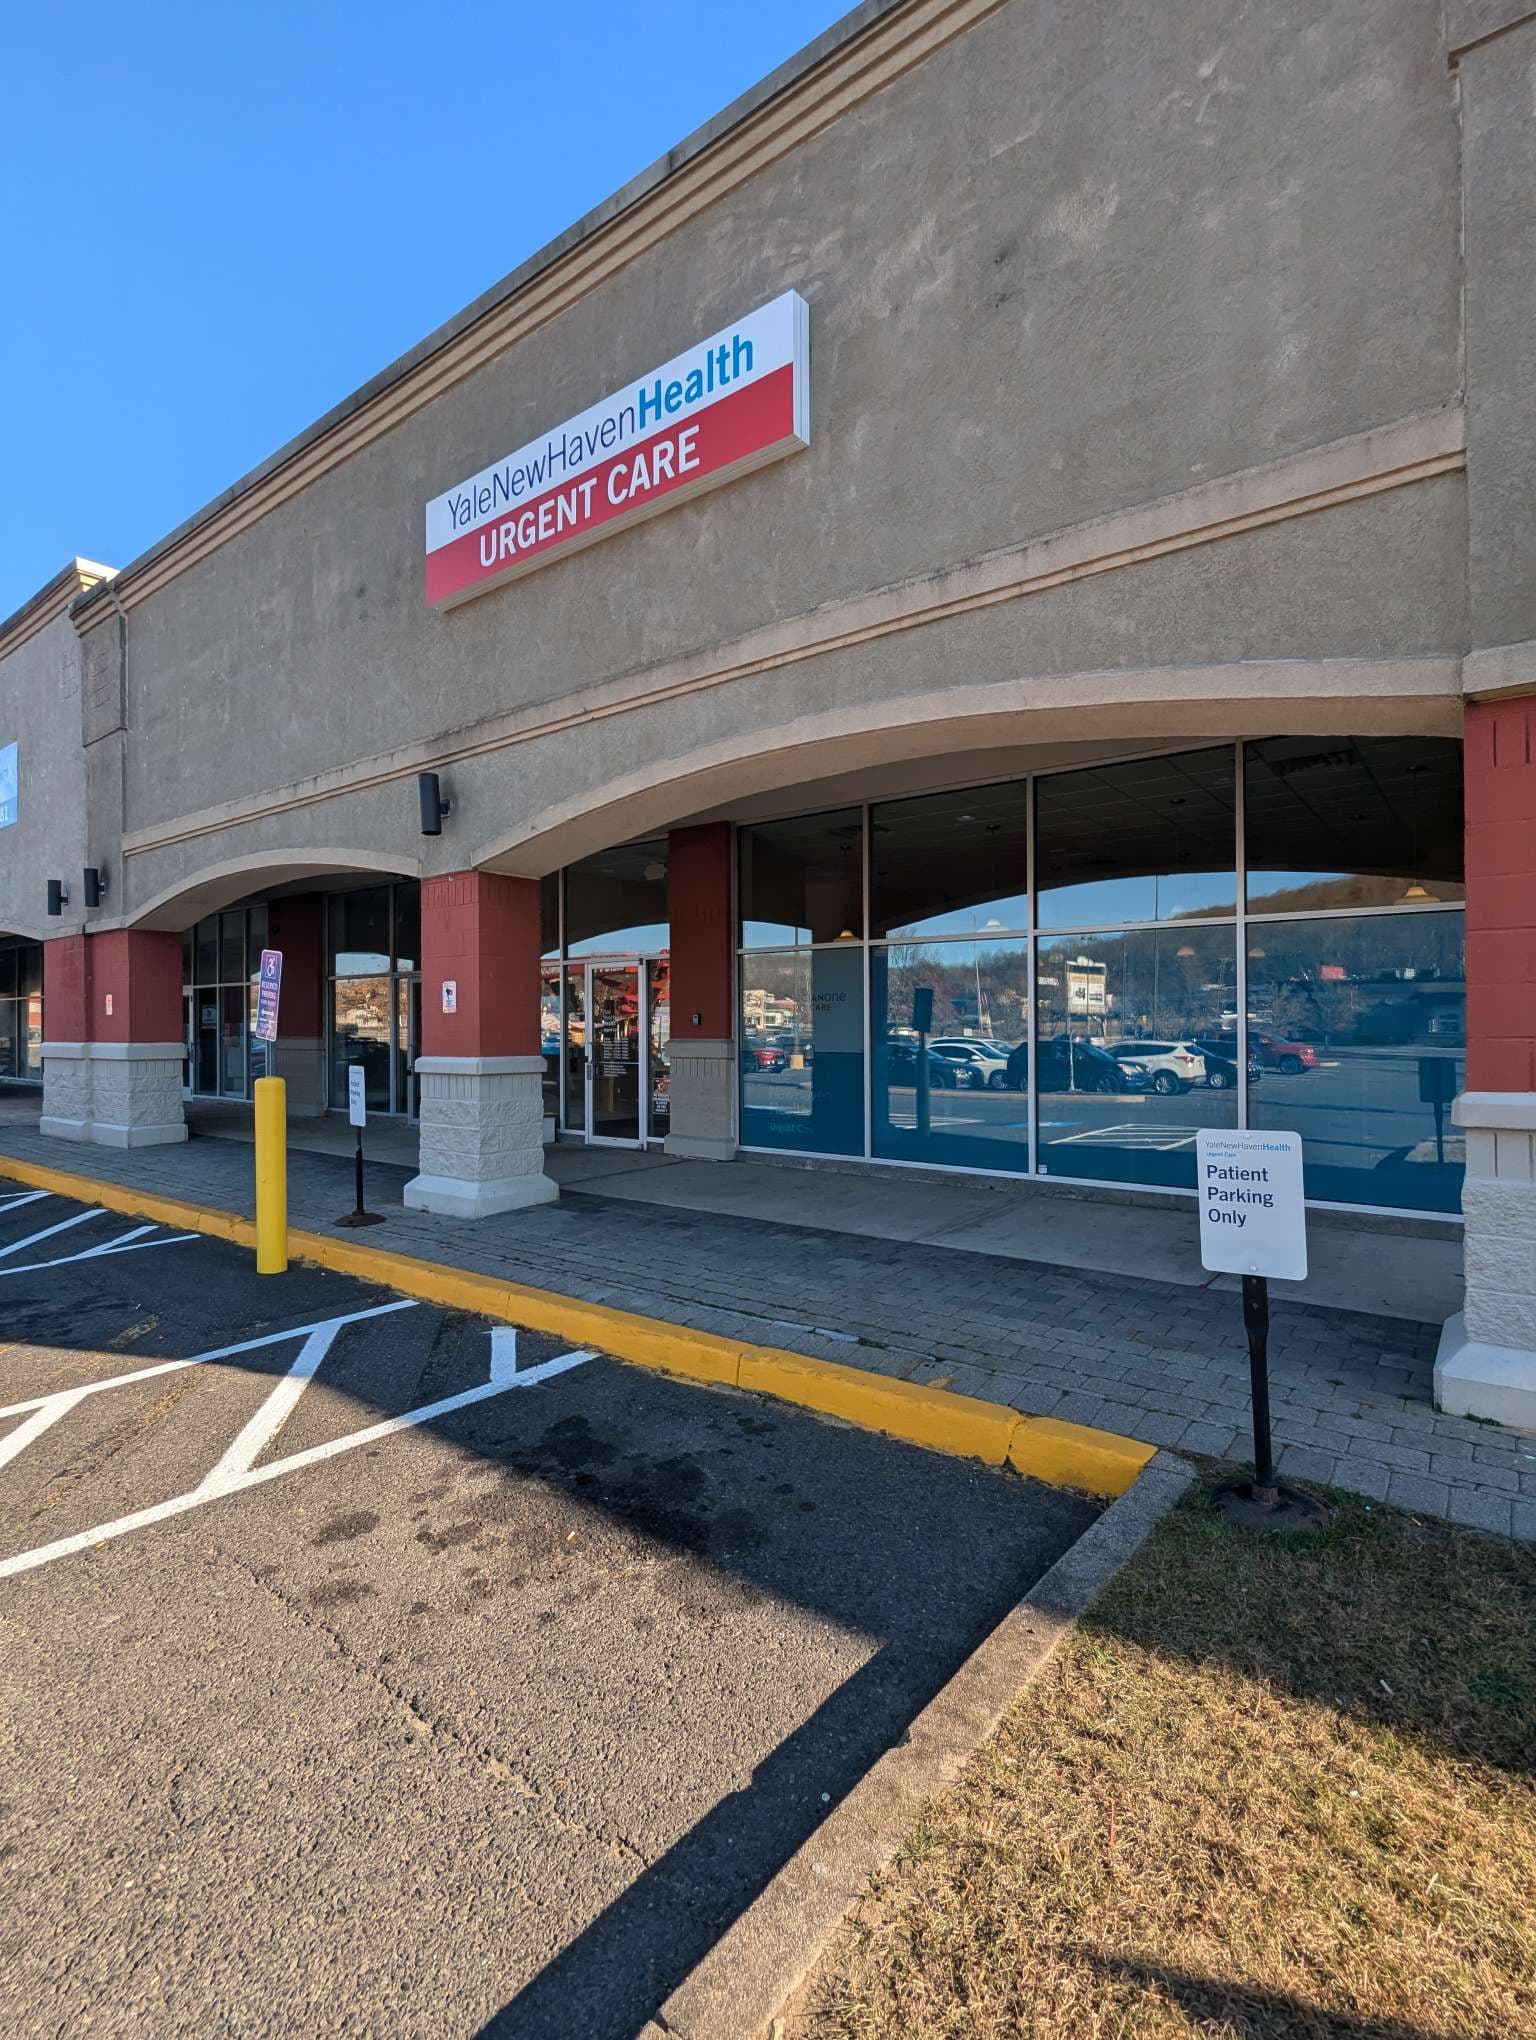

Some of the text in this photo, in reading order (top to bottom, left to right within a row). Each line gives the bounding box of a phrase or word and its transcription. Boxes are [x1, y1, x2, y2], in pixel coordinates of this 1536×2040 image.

[448, 335, 754, 530] YaleNewHavenHealth
[480, 425, 700, 567] URGENT CARE
[1207, 1165, 1269, 1182] Patient
[1208, 1187, 1274, 1208] Parking
[1208, 1208, 1247, 1227] Only
